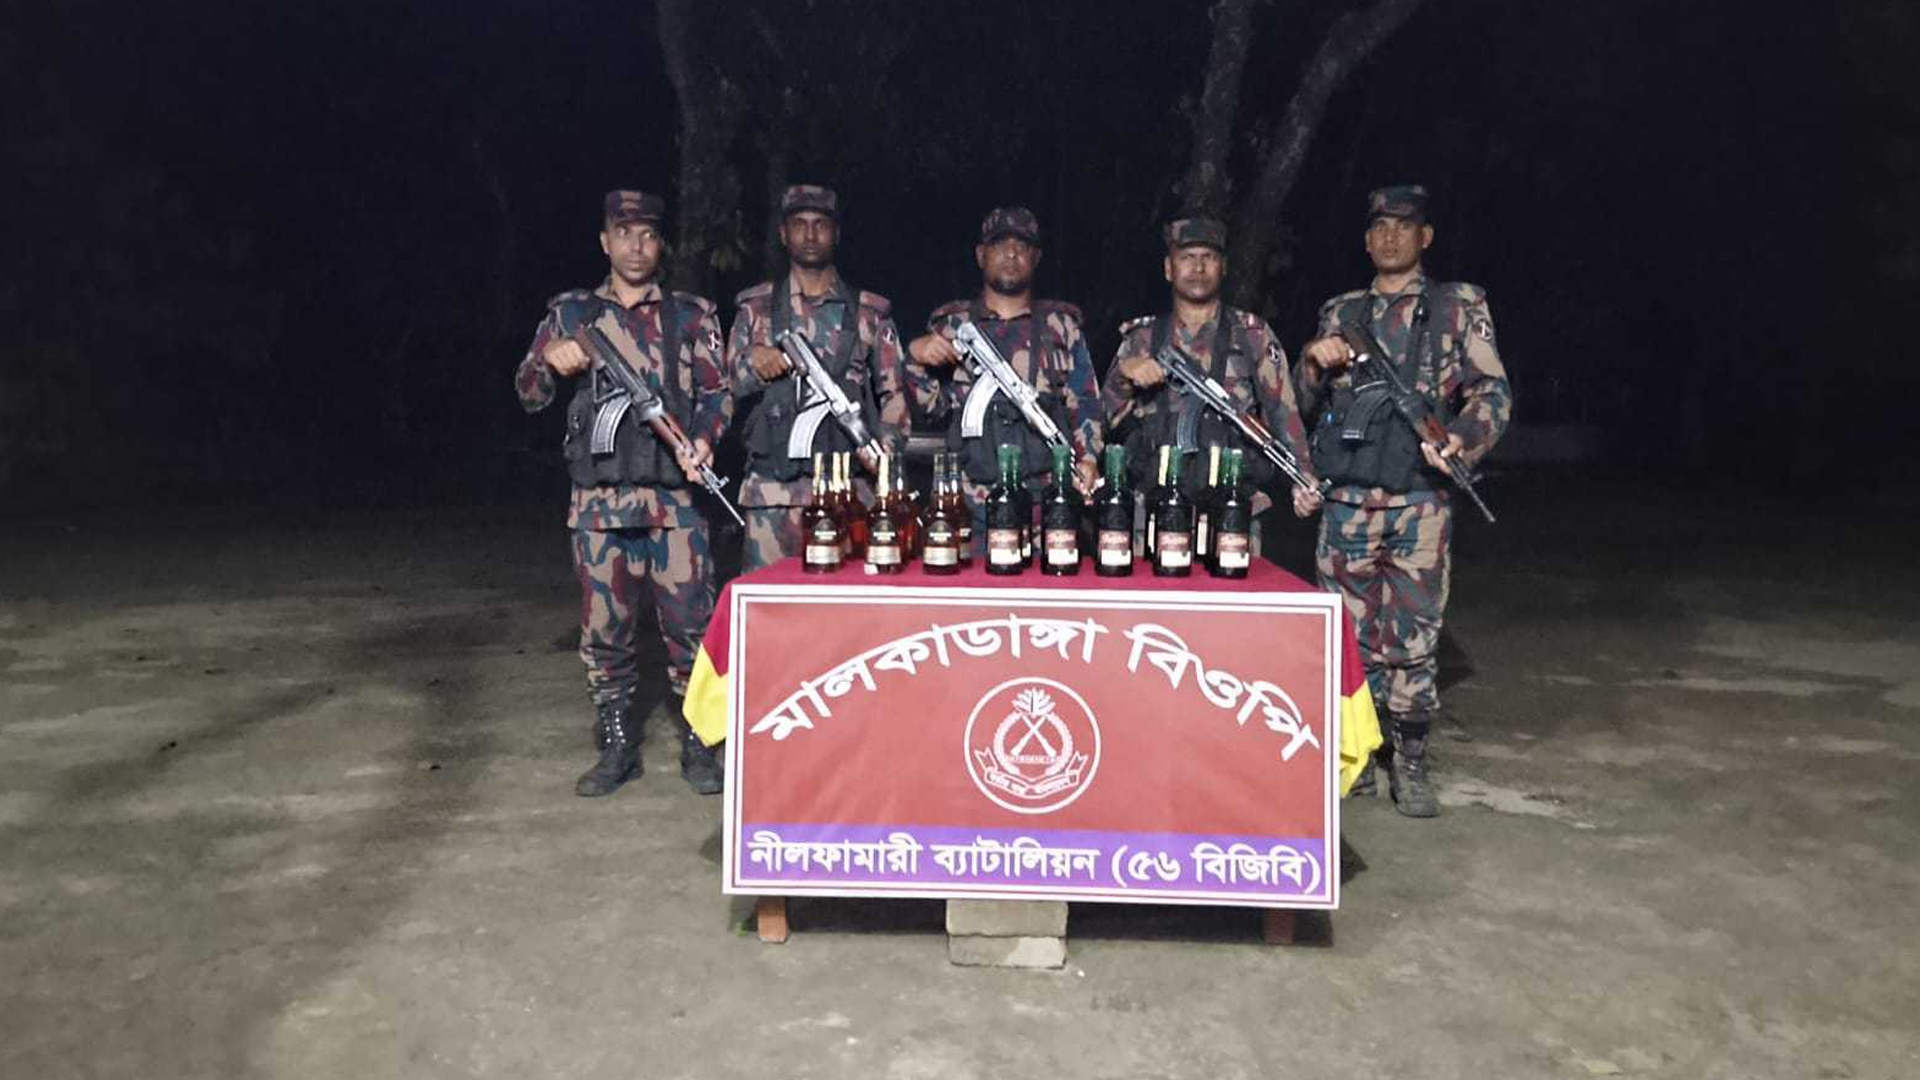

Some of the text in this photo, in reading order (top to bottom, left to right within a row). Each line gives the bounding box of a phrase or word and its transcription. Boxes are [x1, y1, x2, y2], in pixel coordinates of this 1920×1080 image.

[750, 613, 1320, 761] মালকাডাঙ্গা বিওপি
[747, 831, 1322, 896] নীলফামারী ব্যাটালিয়ন (৫৬ বিজিবি)
